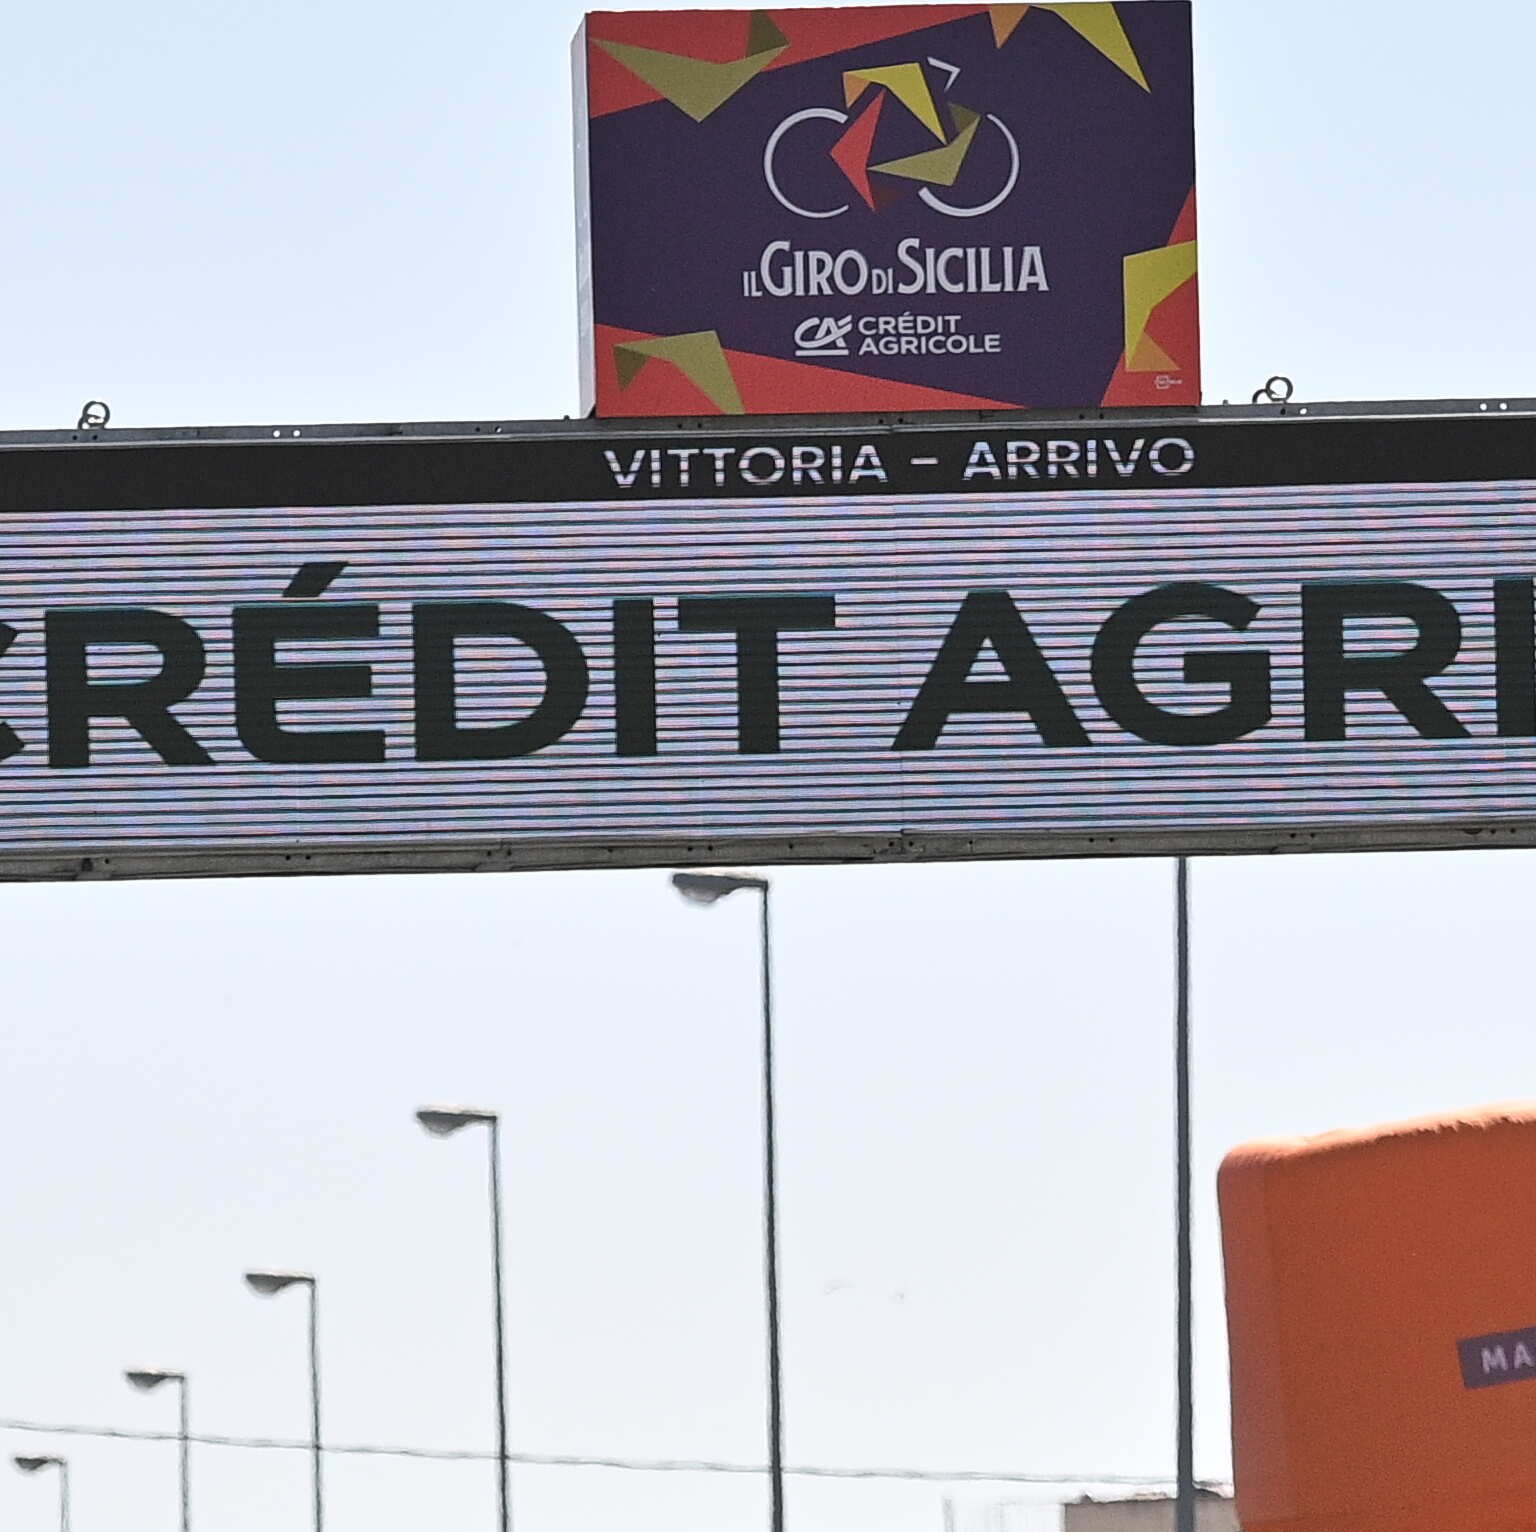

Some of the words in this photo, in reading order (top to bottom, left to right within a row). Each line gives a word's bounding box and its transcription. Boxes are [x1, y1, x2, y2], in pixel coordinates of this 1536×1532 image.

[858, 311, 962, 335] CRÉDIT
[858, 332, 1002, 355] AGRICOLE
[602, 443, 889, 489] VITTORIA
[963, 437, 1196, 482] ARRIVO
